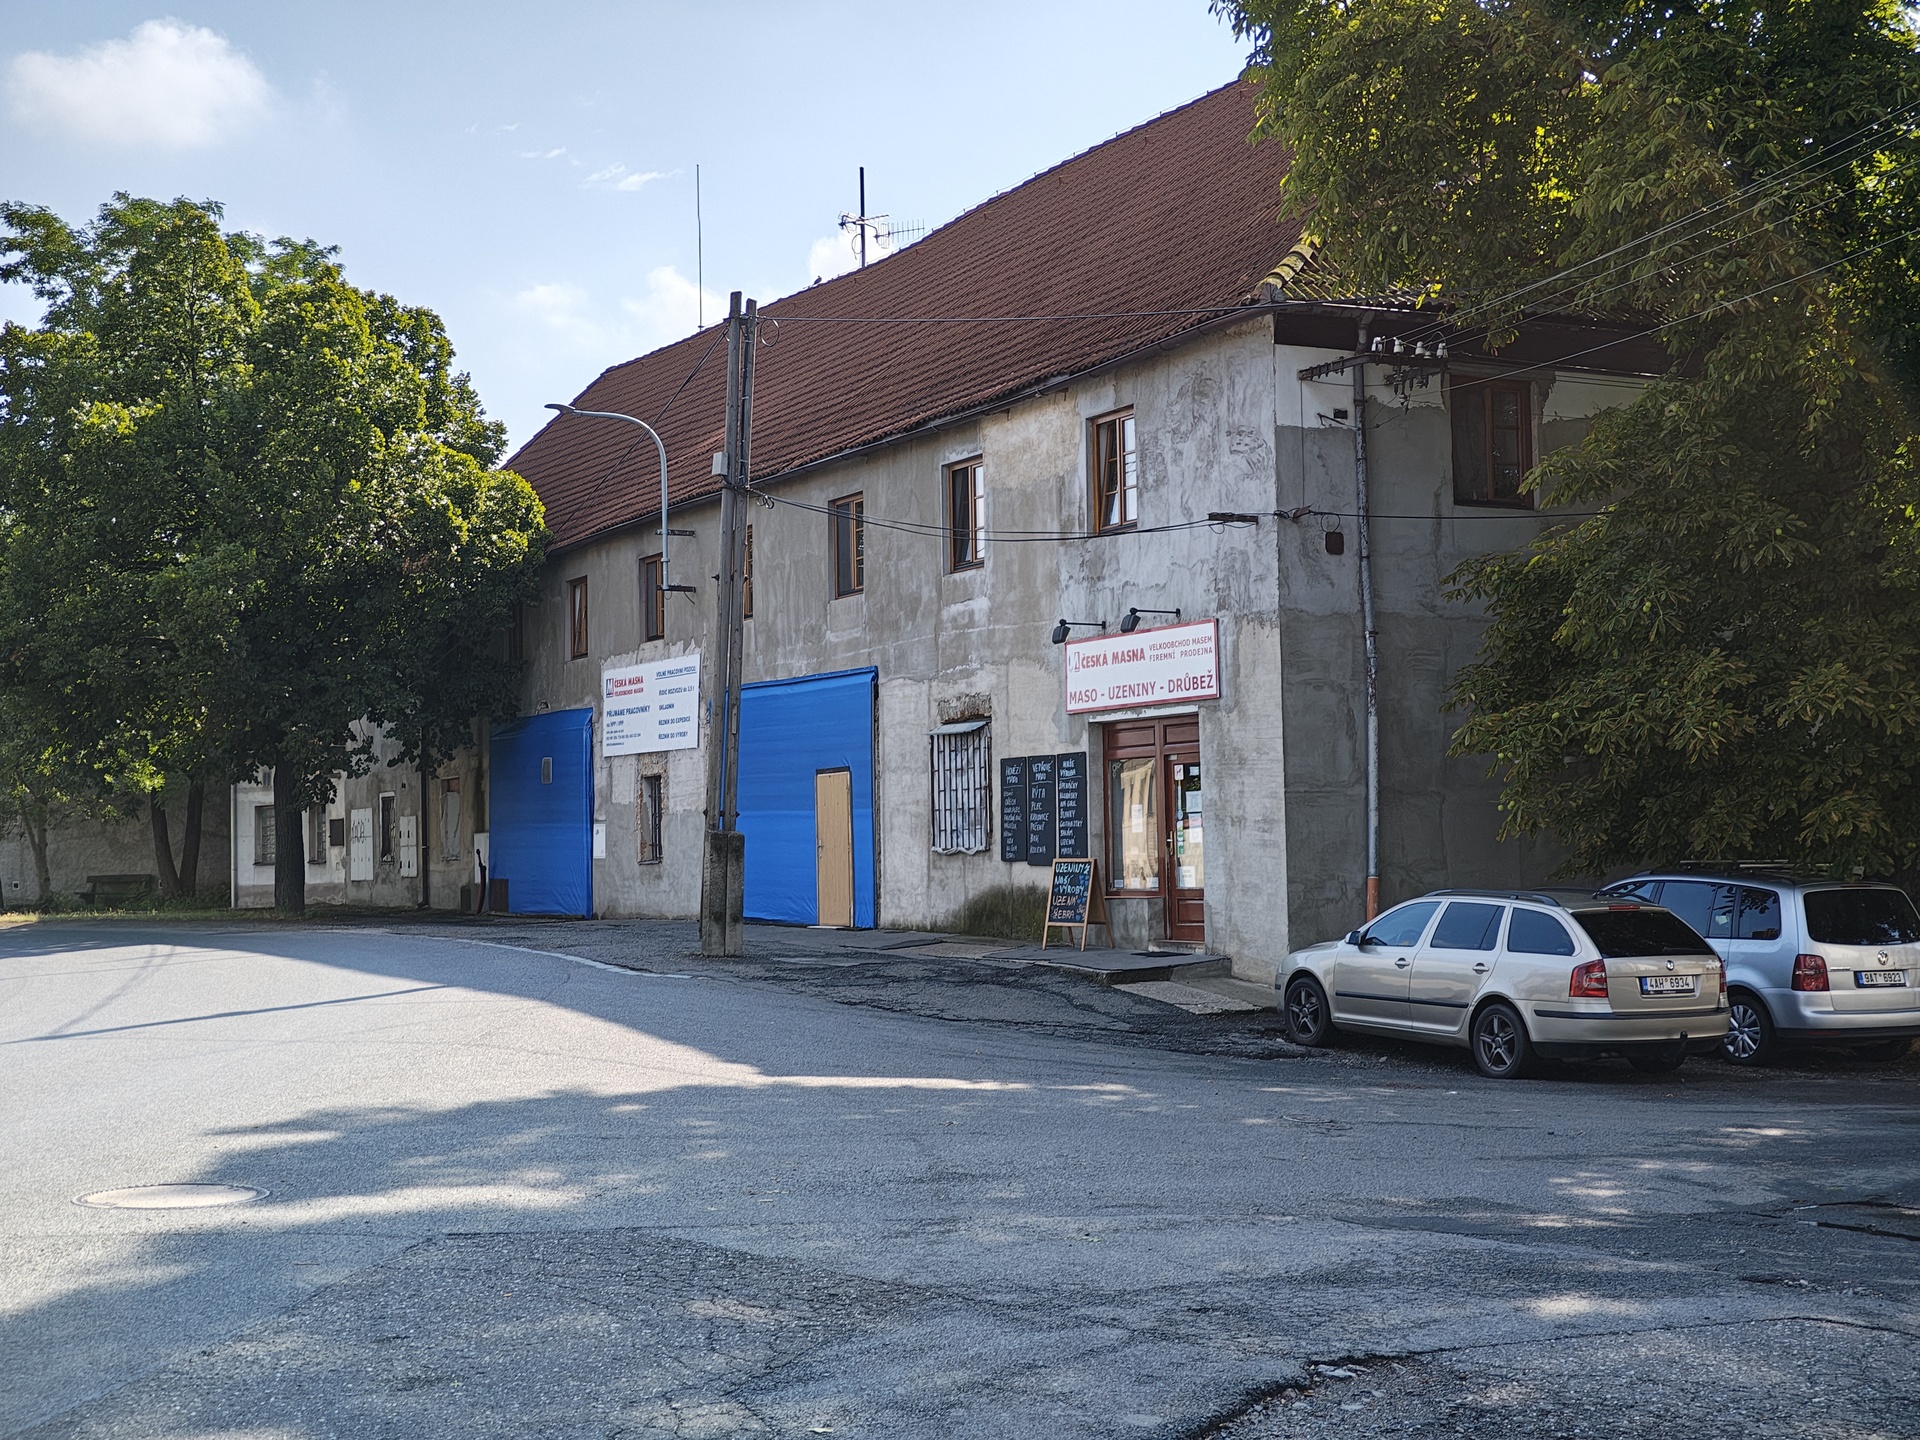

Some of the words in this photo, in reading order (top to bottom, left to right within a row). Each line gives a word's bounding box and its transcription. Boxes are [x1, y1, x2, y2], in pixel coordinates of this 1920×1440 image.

[1149, 639, 1190, 651] VELKOOBCHOD
[1192, 636, 1212, 646] MASEM
[1081, 650, 1108, 669] ČESKÁ
[1112, 648, 1146, 665] MASNA
[1150, 651, 1175, 662] FIREMNÍ
[1180, 647, 1212, 658] PRODEJNA
[614, 676, 627, 688] ČESKÁ
[628, 676, 644, 686] MASNA
[1070, 688, 1098, 704] MASO
[1108, 681, 1156, 700] UZENINY
[1168, 670, 1214, 693] DRŮBEŽ
[626, 704, 650, 715] PRACOVNÍKY
[1063, 758, 1075, 768] NAŠE
[1032, 785, 1045, 798] KÝTA
[1031, 801, 1042, 811] PLEC
[1060, 808, 1076, 818] ŠUNKY
[1056, 863, 1084, 873] UZENINY
[1060, 883, 1084, 896] VÝROBY
[1650, 978, 1665, 990] 4AH
[1670, 976, 1690, 988] 6934
[1865, 974, 1878, 983] 9AT
[1884, 973, 1901, 982] 6923
